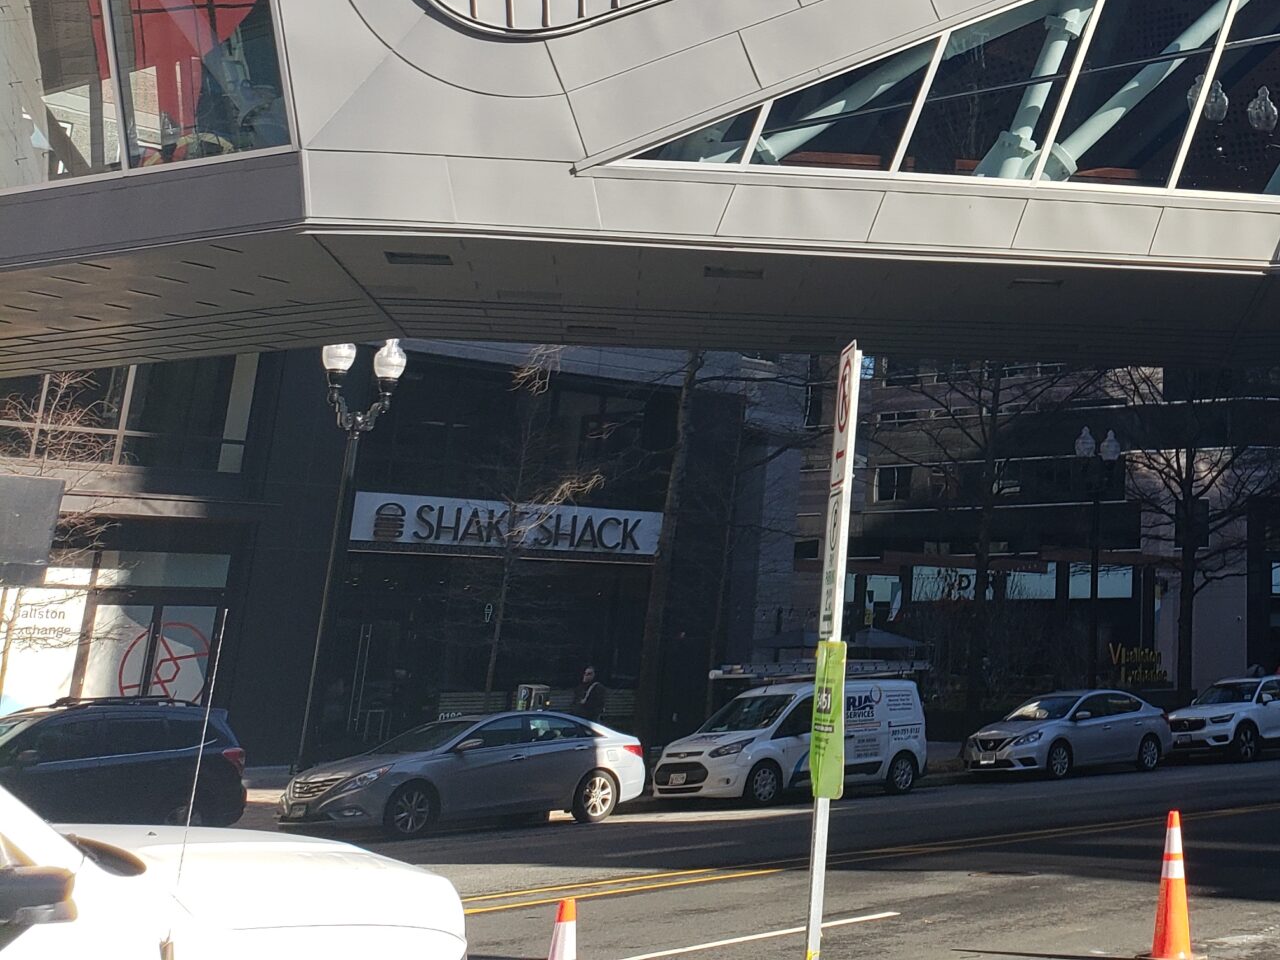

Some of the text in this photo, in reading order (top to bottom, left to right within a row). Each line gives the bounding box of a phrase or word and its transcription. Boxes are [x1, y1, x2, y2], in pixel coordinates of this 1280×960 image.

[533, 512, 643, 551] SHACK
[15, 606, 66, 620] allston
[15, 624, 71, 638] xchange
[846, 710, 875, 719] SERVICES
